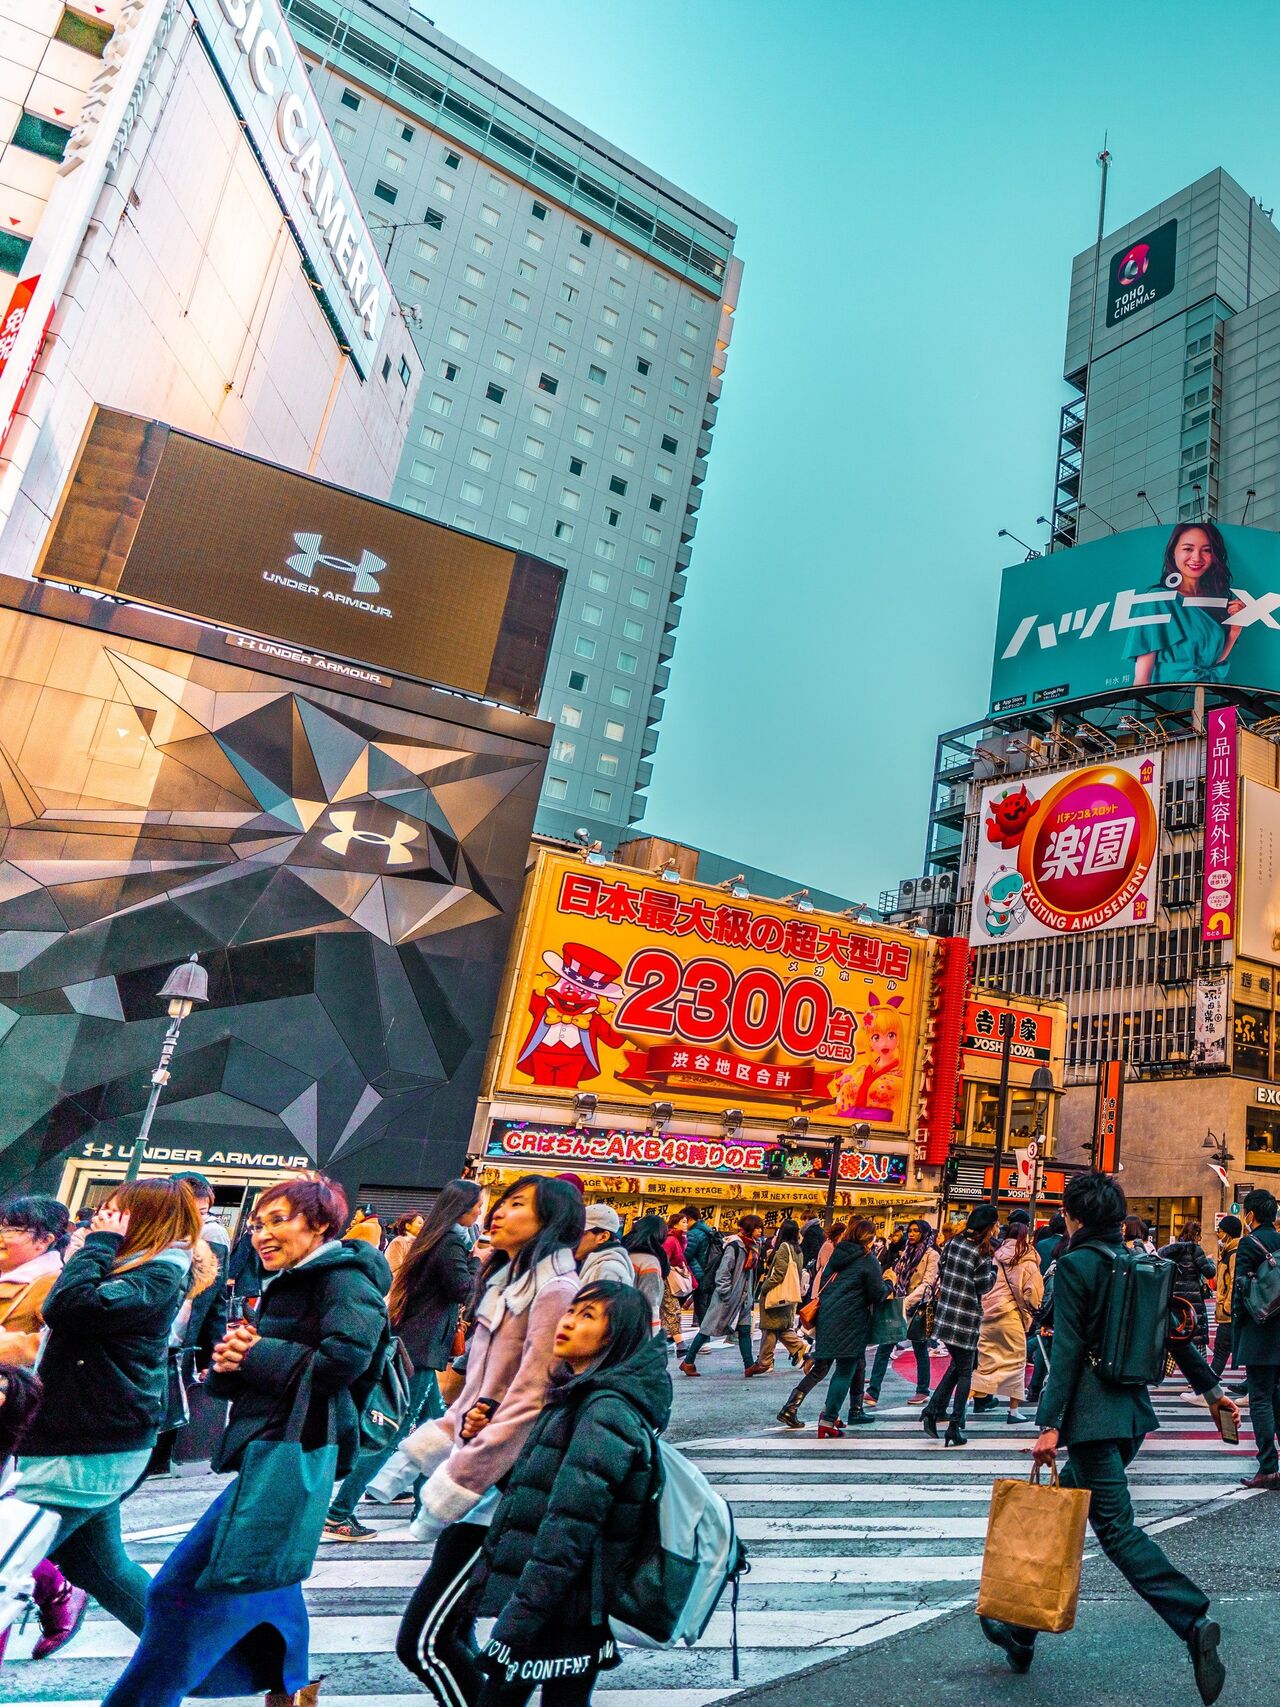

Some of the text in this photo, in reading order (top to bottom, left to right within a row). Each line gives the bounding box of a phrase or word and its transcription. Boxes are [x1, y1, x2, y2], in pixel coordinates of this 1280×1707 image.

[278, 91, 380, 341] CAMERA
[1114, 289, 1156, 319] CINEMAS
[1115, 284, 1145, 308] TOHO
[0, 307, 25, 360] 免税
[262, 570, 320, 597] UNDER
[258, 643, 384, 684] UNDER ARMOUR
[1141, 766, 1153, 776] 40
[1056, 804, 1119, 825] パチンコ&スロット
[1210, 737, 1231, 868] 品川美容外科
[1037, 816, 1136, 883] 楽園
[1022, 862, 1149, 931] EXCITING AMUSEMENT
[1134, 902, 1146, 910] 30
[559, 872, 912, 982] 日本最大級の超大型店
[788, 961, 897, 990] メガホール
[976, 1009, 1038, 1043] 吉野家
[817, 1043, 853, 1059] OVER
[973, 1037, 1036, 1059] YOSHNOYA
[671, 1051, 791, 1087] 渋谷地区合計
[117, 1145, 310, 1169] UNDER ARMOUR
[1029, 1144, 1036, 1156] 3
[583, 1180, 601, 1188] AGE
[648, 1183, 723, 1196] 無双 NEXT STAGE
[752, 1189, 769, 1201] 無双
[950, 1187, 982, 1195] YOSHINOYA
[720, 1208, 743, 1219] NEXT
[723, 1217, 739, 1227] STA
[764, 1207, 793, 1227] 無双
